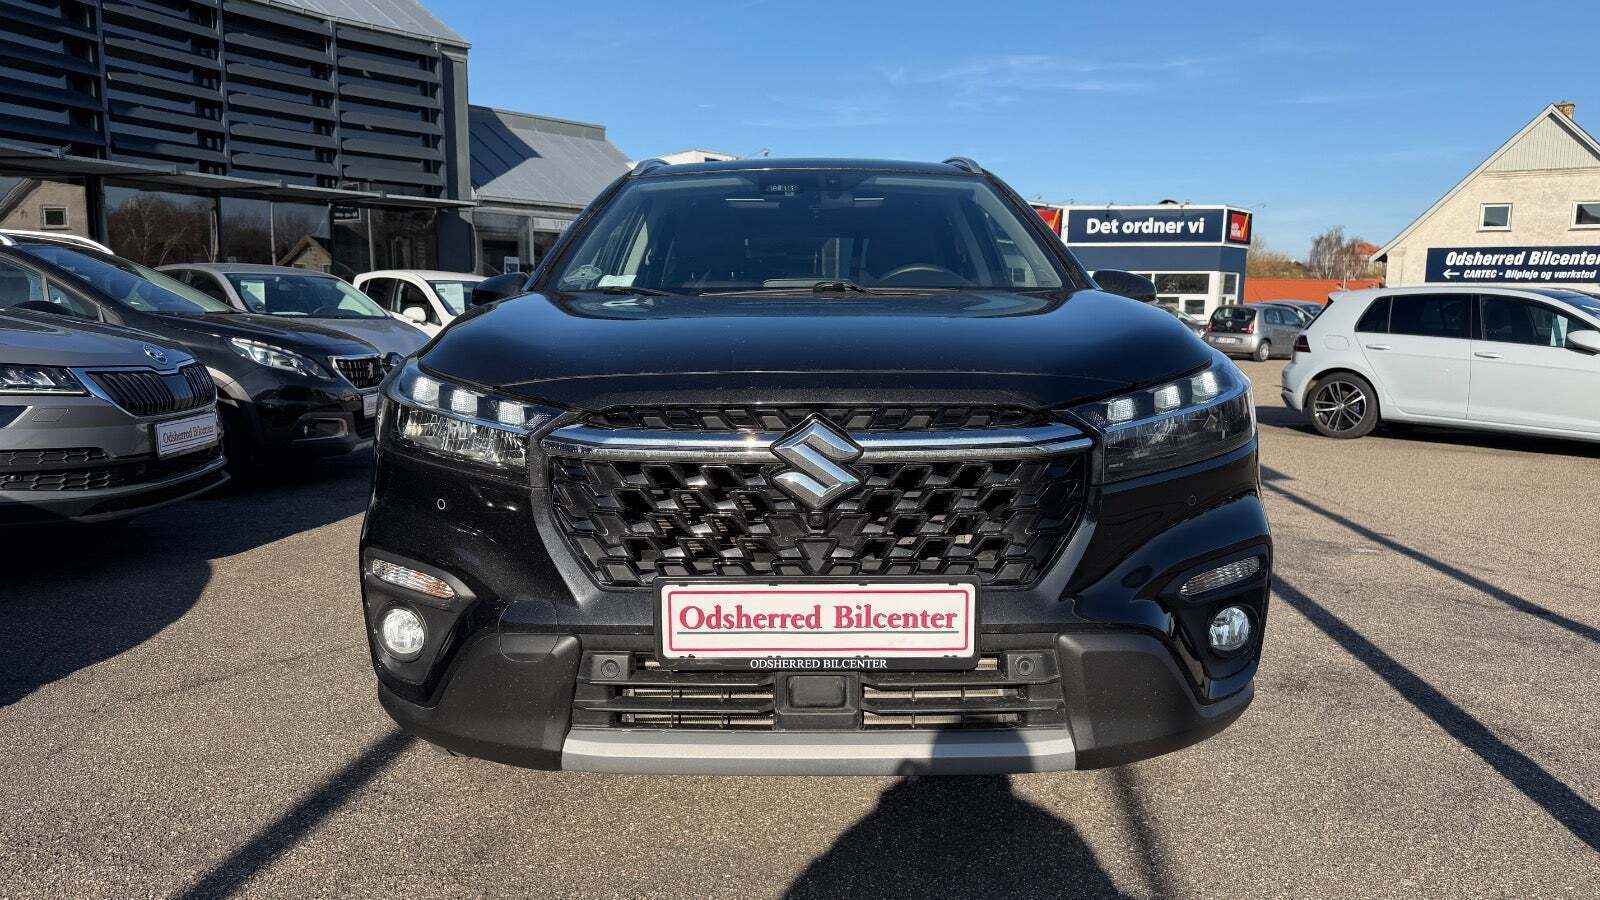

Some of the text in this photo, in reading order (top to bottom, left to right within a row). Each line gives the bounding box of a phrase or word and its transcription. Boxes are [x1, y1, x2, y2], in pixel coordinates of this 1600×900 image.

[1086, 218, 1205, 234] Det ordner vi
[1445, 251, 1526, 266] Odsherred
[1463, 270, 1497, 278] CARTEC
[1540, 271, 1552, 280] og
[1554, 270, 1597, 279] værksted
[679, 604, 958, 630] Odsherred Bilcenter
[750, 658, 887, 669] ODSHERRED BILCENTER
